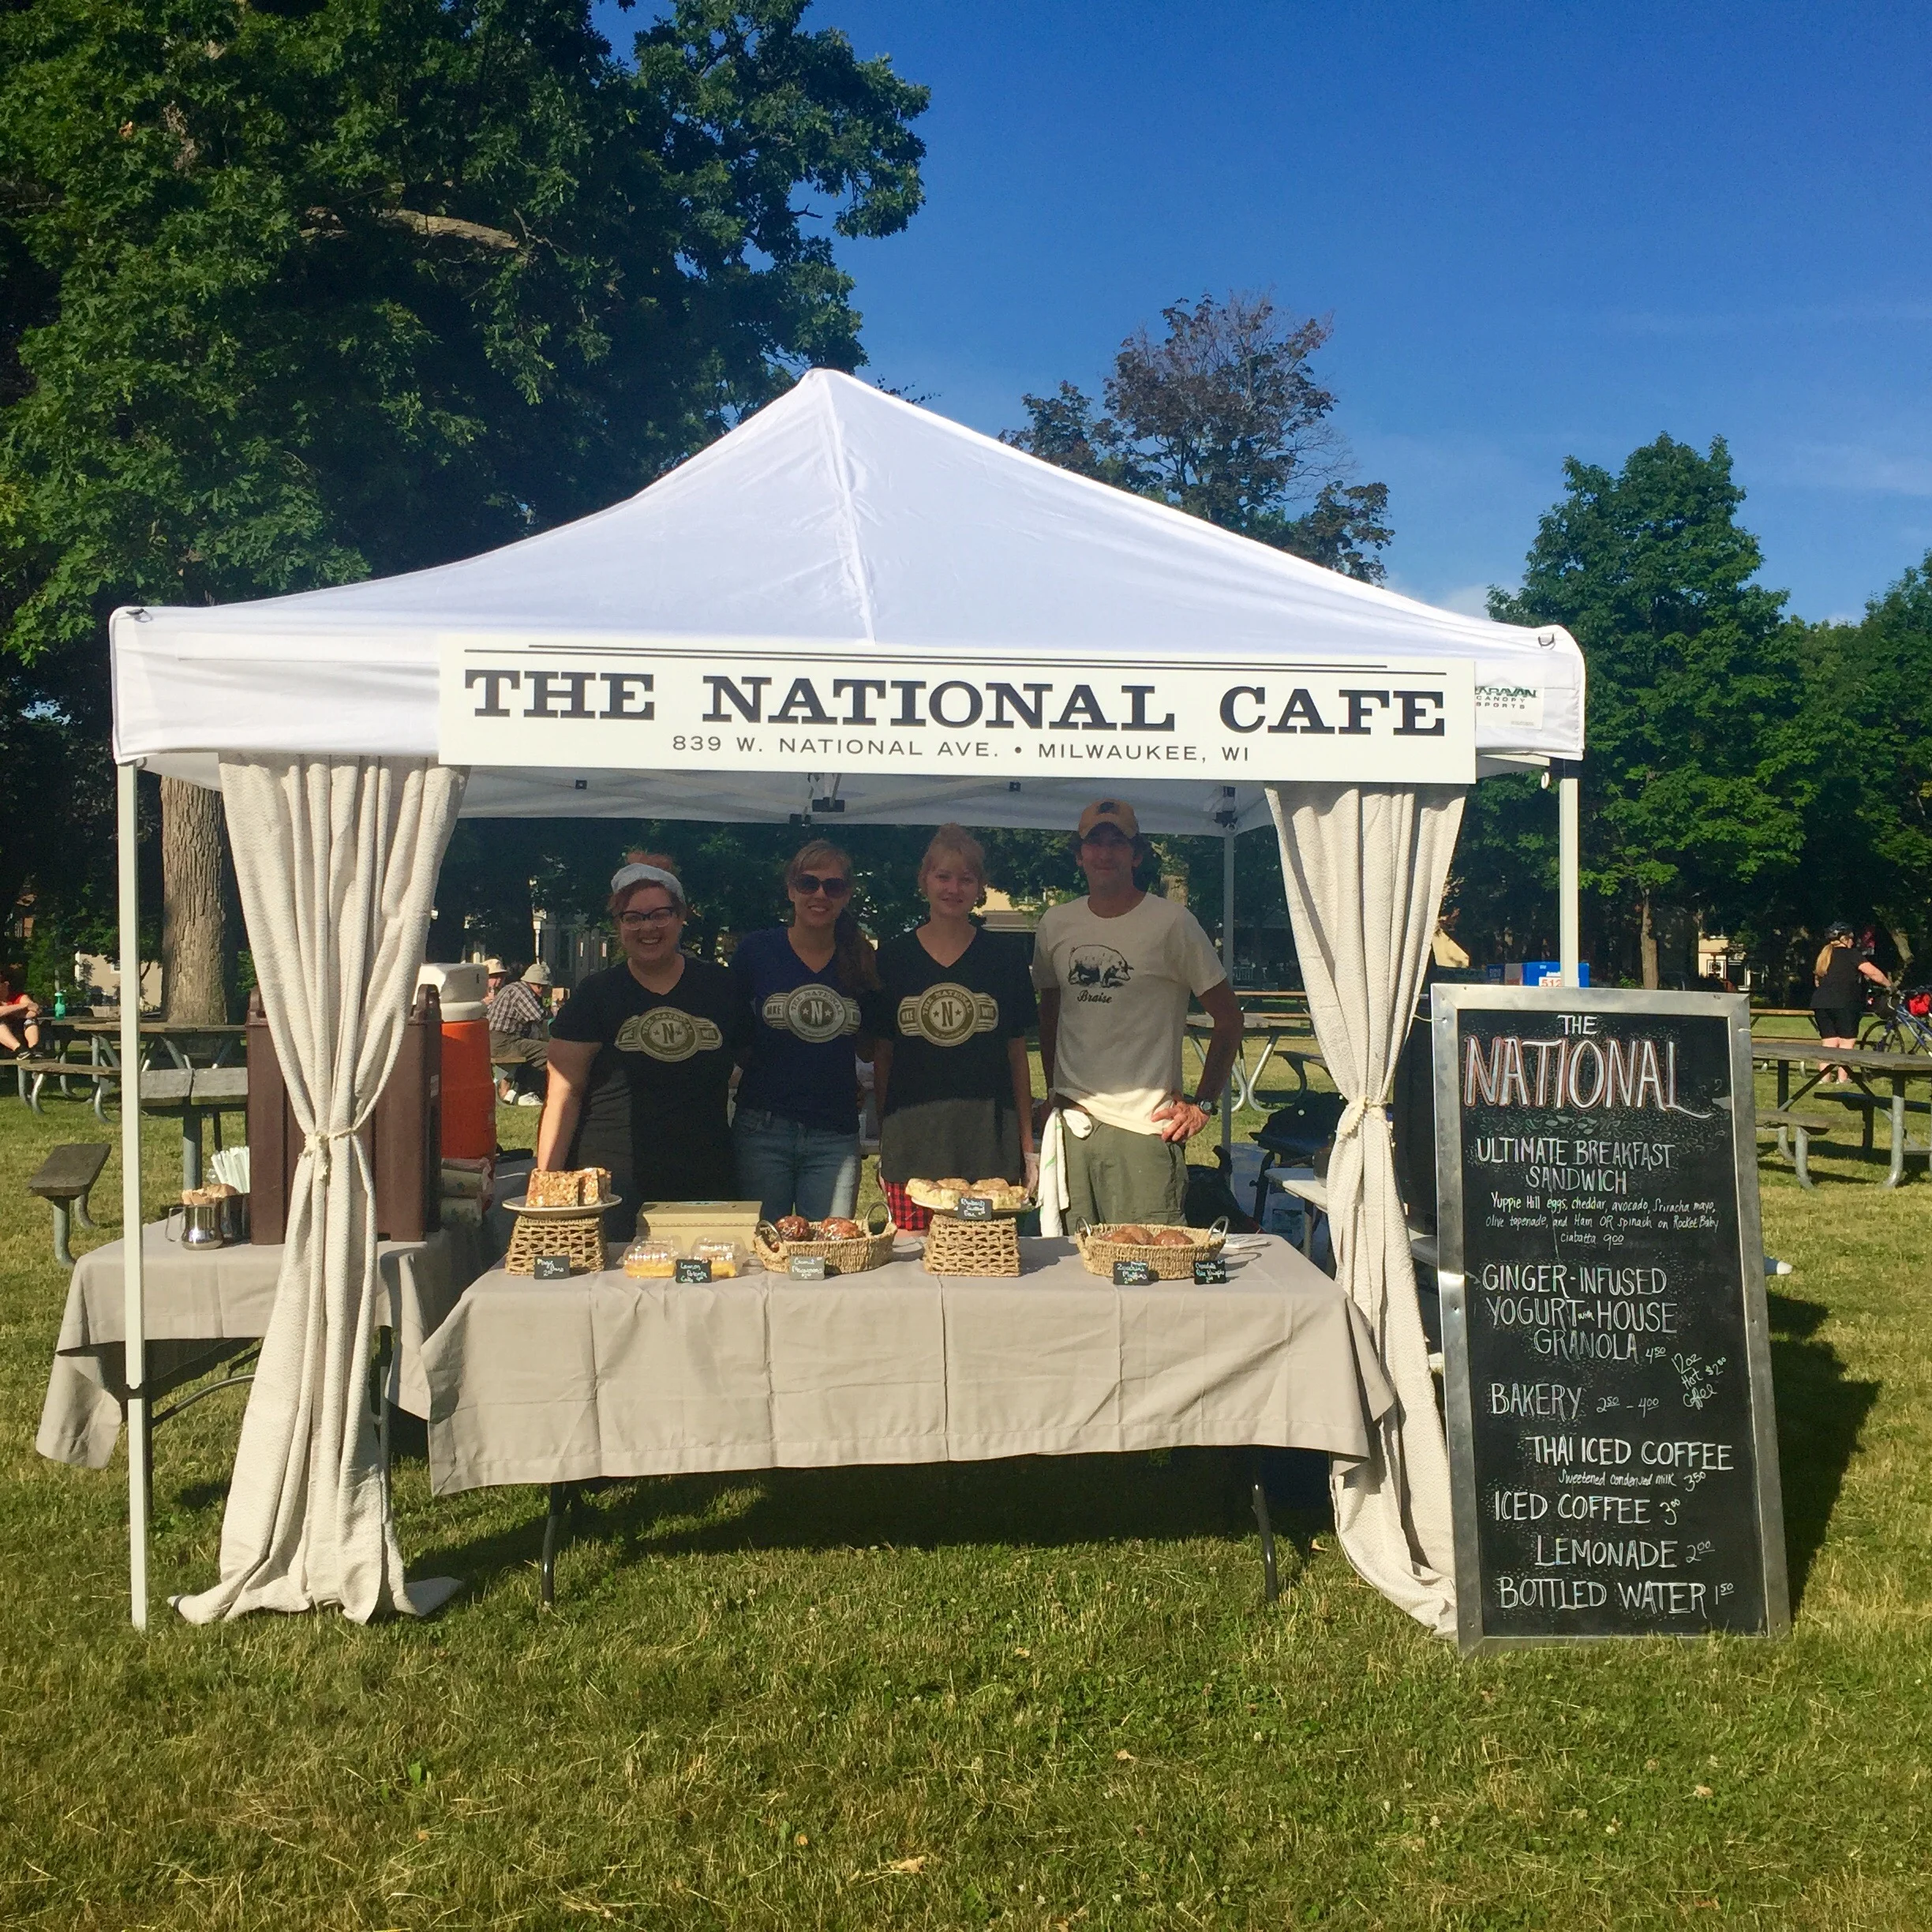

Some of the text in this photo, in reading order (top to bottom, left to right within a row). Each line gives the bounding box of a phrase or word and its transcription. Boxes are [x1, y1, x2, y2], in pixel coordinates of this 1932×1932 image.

[465, 669, 1445, 736] THE NATIONAL CAFE
[673, 735, 1249, 763] 839 W. NATIONAL AVE. MILWAUKEE, WI
[923, 997, 934, 1016] THE
[934, 990, 974, 1013] NATIONAL
[1077, 990, 1113, 1004] Braise
[811, 1000, 823, 1025] N
[941, 1001, 953, 1028] N
[1557, 1014, 1598, 1035] THE
[661, 1022, 674, 1044] N
[1464, 1035, 1713, 1119] NATIONAL
[1477, 1137, 1676, 1171] ULTIMATE BREAKFAST
[1526, 1165, 1627, 1194] SANDWICH
[1491, 1191, 1522, 1214] Yuppie
[1526, 1196, 1541, 1210] Hill
[1552, 1216, 1568, 1228] and
[1574, 1215, 1593, 1227] Ham
[1599, 1215, 1614, 1230] OR
[1616, 1216, 1652, 1231] spinach
[1657, 1219, 1668, 1229] on
[1673, 1215, 1698, 1230] Rocket
[1698, 1215, 1719, 1233] Baby
[1560, 1231, 1597, 1245] ciabatta
[1486, 1295, 1678, 1333] YOGURT with HOUSE
[1533, 1328, 1639, 1365] GRANOLA
[1681, 1367, 1704, 1390] Hot
[1491, 1383, 1582, 1421] BAKERY
[1525, 1436, 1734, 1470] THAI ICED COFFEE
[1558, 1468, 1606, 1485] Sweetened
[1495, 1490, 1548, 1521] ICED
[1557, 1493, 1651, 1524] COFFEE
[1534, 1534, 1679, 1571] LEMONADE
[1495, 1576, 1608, 1610] BOTTLED
[1616, 1580, 1708, 1619] WATER
